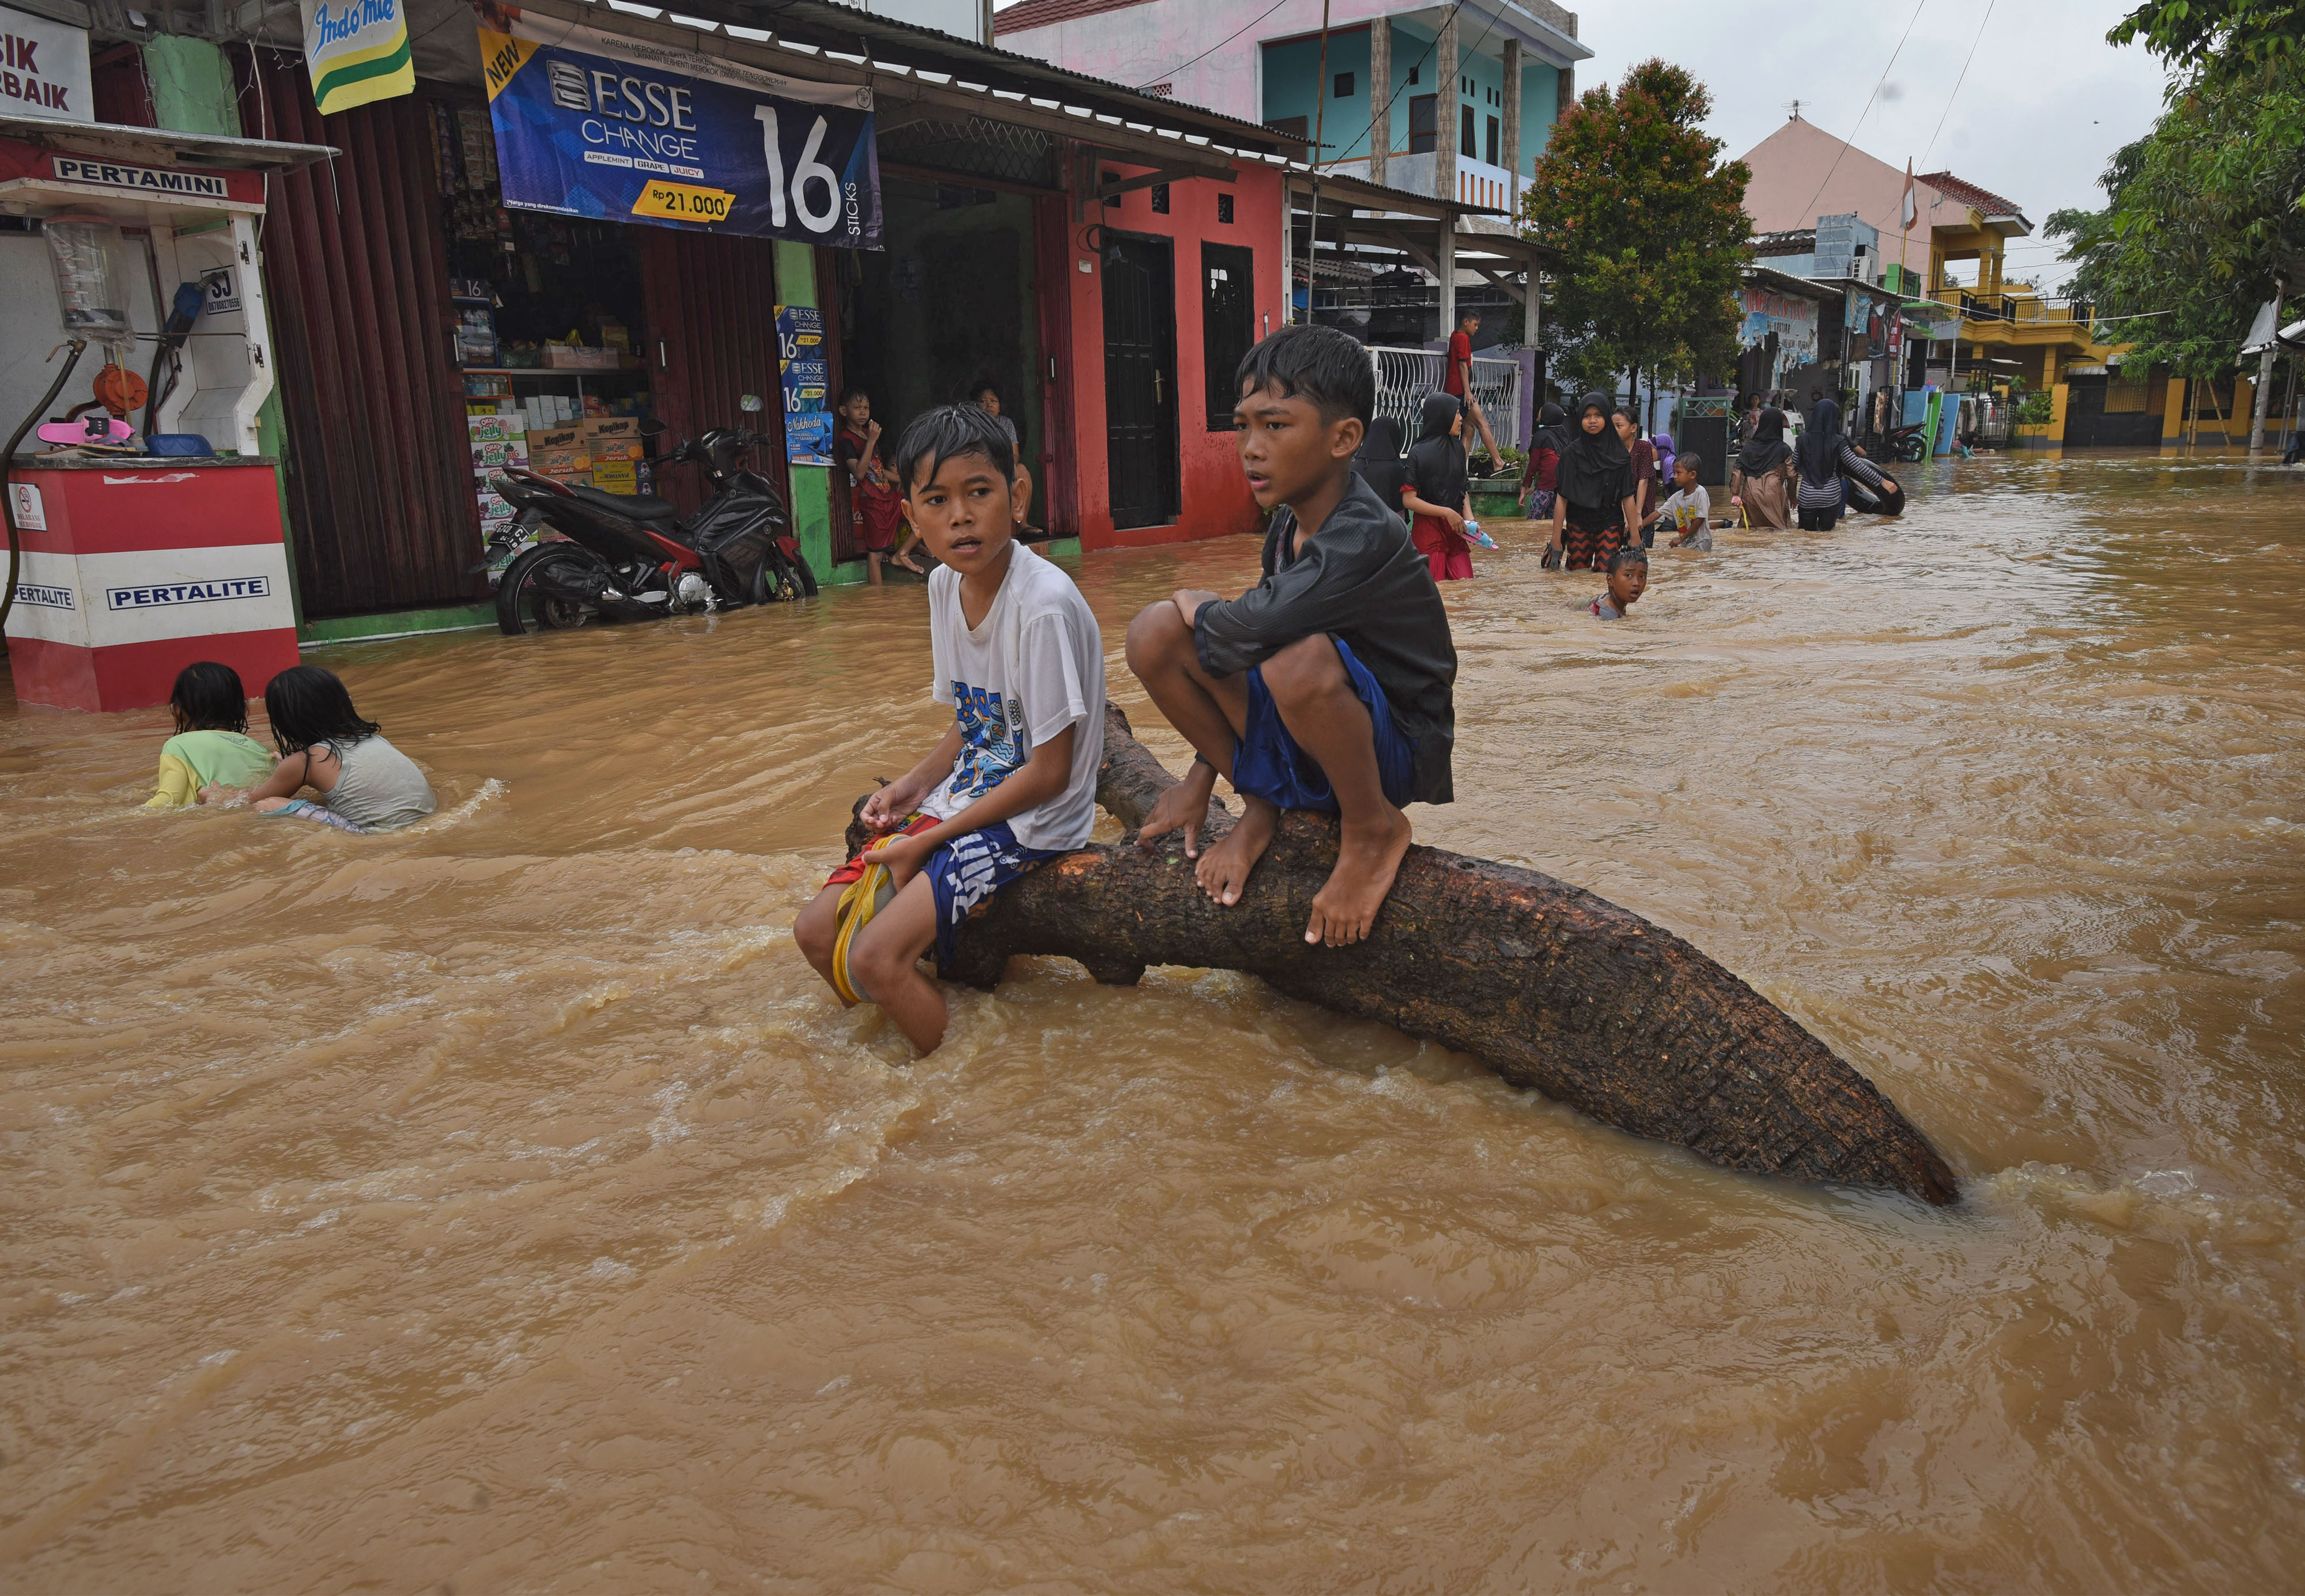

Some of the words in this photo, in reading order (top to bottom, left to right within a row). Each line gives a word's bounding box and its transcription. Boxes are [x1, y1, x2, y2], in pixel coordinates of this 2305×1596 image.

[486, 39, 520, 89] NEW
[602, 37, 630, 50] KARENA
[742, 70, 788, 86] TENGGOROKAN
[634, 52, 663, 63] LAYANAN
[663, 57, 690, 70] BERHENTI
[690, 63, 719, 76] MEROKOK
[591, 70, 697, 132] ESSE
[581, 119, 700, 161] CHANGE
[587, 153, 630, 165] APPLEMINT
[637, 160, 666, 171] GRAPE
[674, 167, 701, 176] JUICY
[754, 104, 841, 233] 16
[59, 160, 223, 194] PERTAMINI
[536, 203, 579, 214] direkomendasikan
[845, 182, 861, 236] STICKS
[467, 280, 481, 297] 16
[799, 309, 821, 321] ESSE
[795, 321, 822, 330] CHANGE
[779, 332, 797, 358] 16
[801, 363, 824, 374] ESSE
[798, 375, 824, 383] CHANGE
[784, 387, 801, 412] 16
[481, 417, 497, 425] OKKY
[599, 421, 629, 434] Kopikap
[787, 414, 822, 432] Nakhoda
[479, 425, 502, 439] jelly
[502, 424, 516, 434] BIG
[544, 432, 575, 446] Kopikap
[485, 443, 502, 451] OKKY
[484, 451, 507, 464] jelly
[507, 449, 519, 460] BIG
[489, 502, 512, 516] jelly
[17, 513, 41, 521] DILARANG
[19, 521, 42, 529] MEROKOK
[114, 580, 264, 606] PERTALITE
